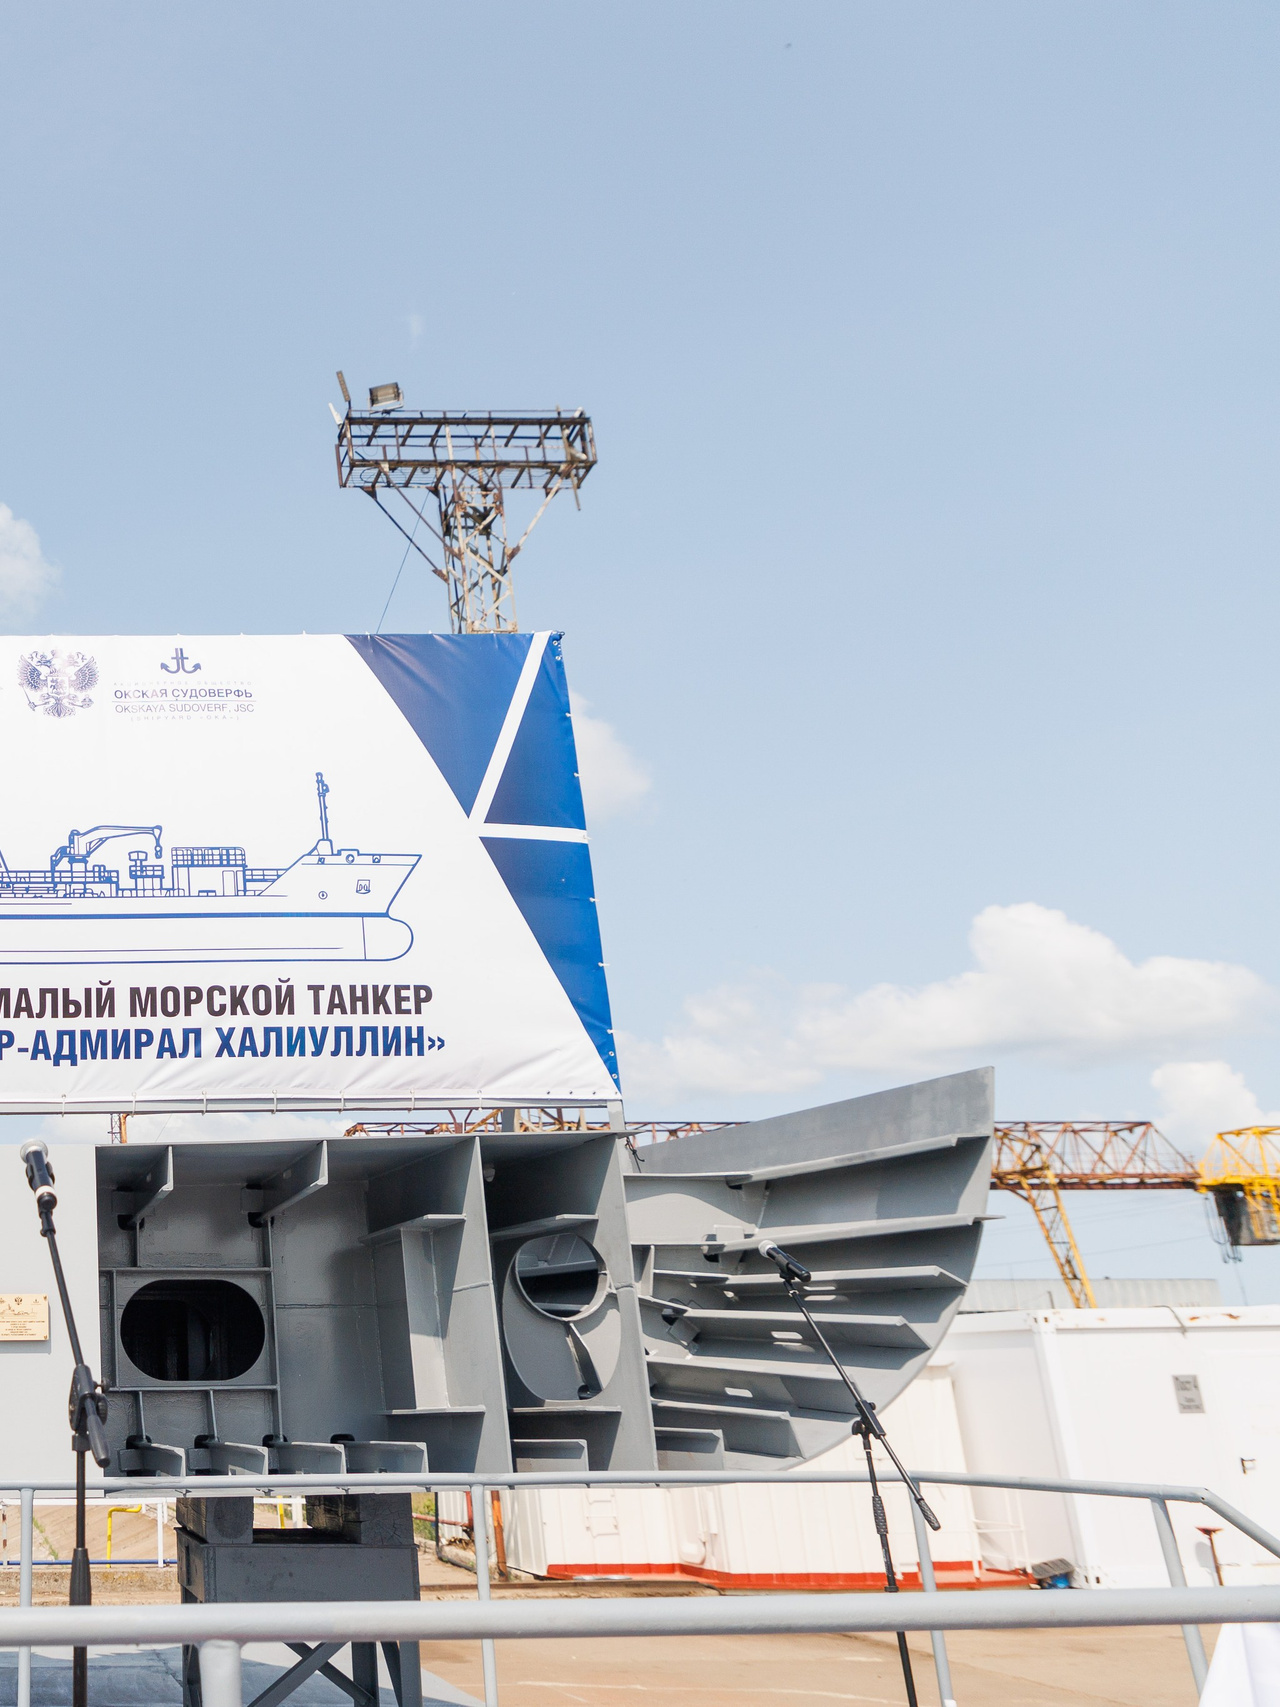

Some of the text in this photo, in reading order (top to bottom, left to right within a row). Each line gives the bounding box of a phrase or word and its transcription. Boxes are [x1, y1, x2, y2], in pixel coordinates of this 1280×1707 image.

[114, 688, 253, 700] ОКСКАЯ СУДОВЕРФЬ
[115, 703, 255, 713] OKSKAYA SUDOVERF, JSC
[130, 978, 295, 1018] МОРСКОЙ
[307, 983, 433, 1015] ТАНКЕР
[214, 1025, 446, 1059] ХАЛИУЛЛИН»
